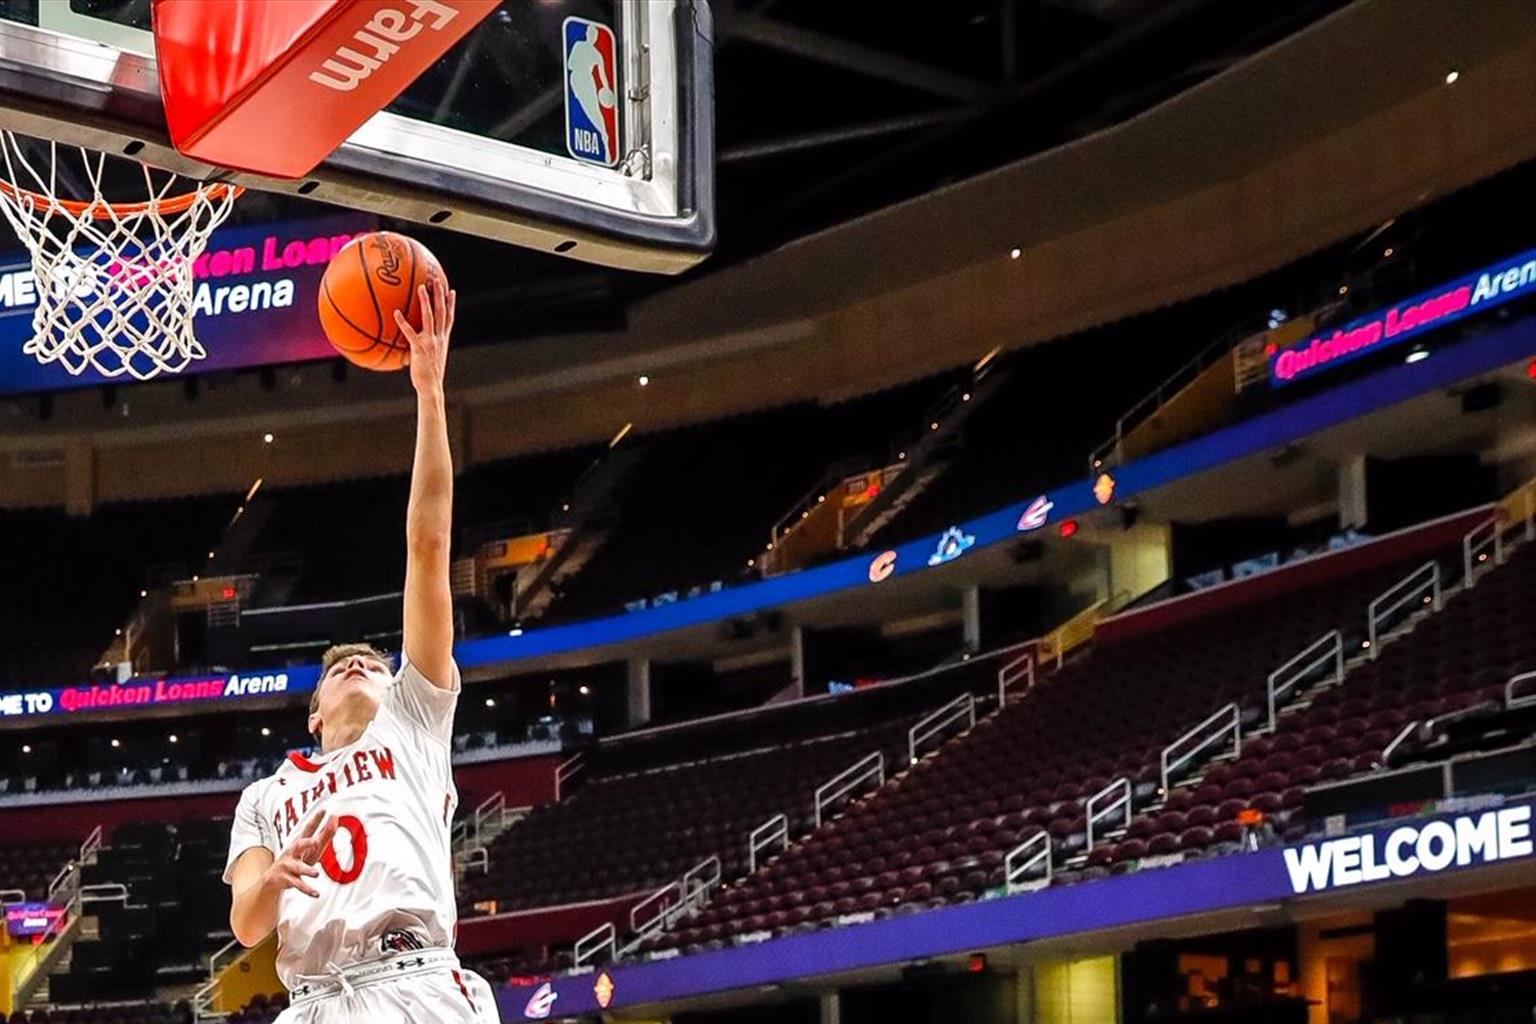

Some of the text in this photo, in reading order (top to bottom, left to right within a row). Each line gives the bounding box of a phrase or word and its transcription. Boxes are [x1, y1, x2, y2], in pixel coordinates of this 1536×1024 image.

[309, 0, 460, 92] Farm
[574, 128, 601, 155] NBA
[262, 231, 369, 271] Loan
[192, 276, 294, 318] Arena
[24, 692, 53, 713] TO
[59, 682, 152, 711] Quicken
[154, 678, 225, 702] Loans
[223, 674, 289, 696] Arena
[318, 815, 368, 885] 0
[1283, 805, 1534, 894] WELCOME
